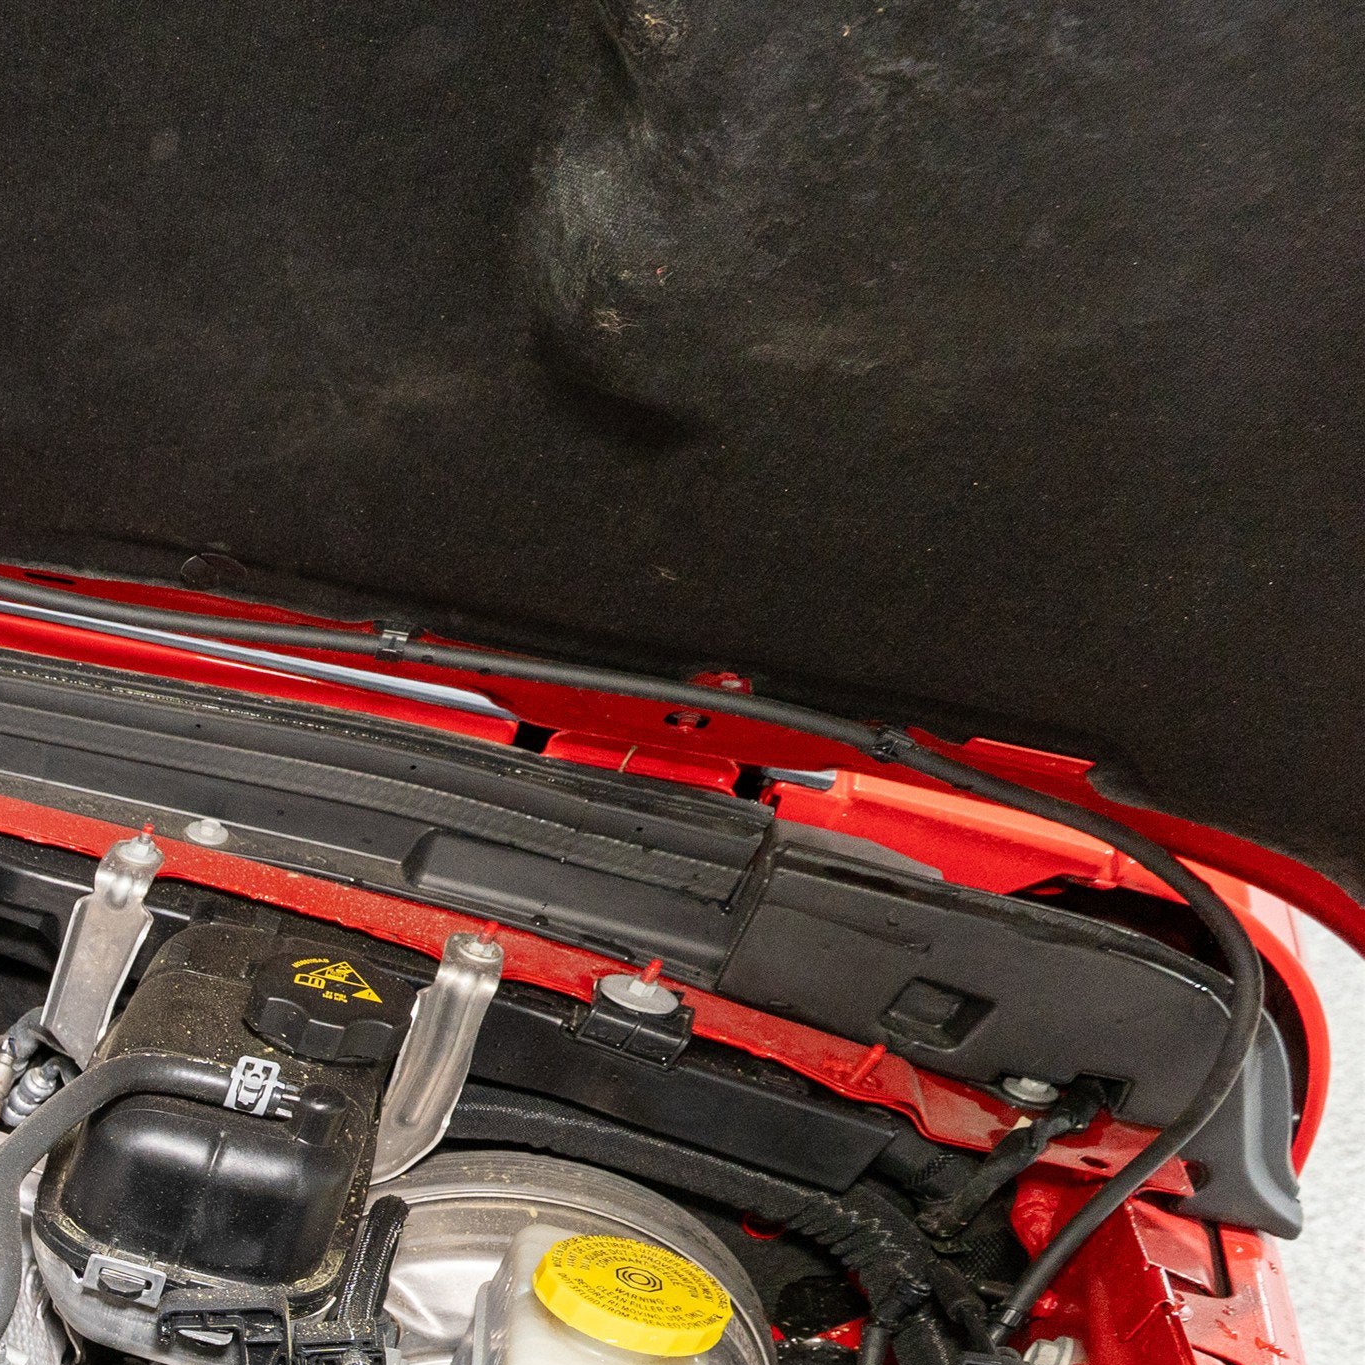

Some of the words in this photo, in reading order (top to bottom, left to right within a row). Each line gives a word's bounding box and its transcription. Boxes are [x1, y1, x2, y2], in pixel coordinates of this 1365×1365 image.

[596, 1285, 628, 1303] CLEAN
[629, 1300, 664, 1313] FILLER
[601, 1303, 630, 1318] FROM
